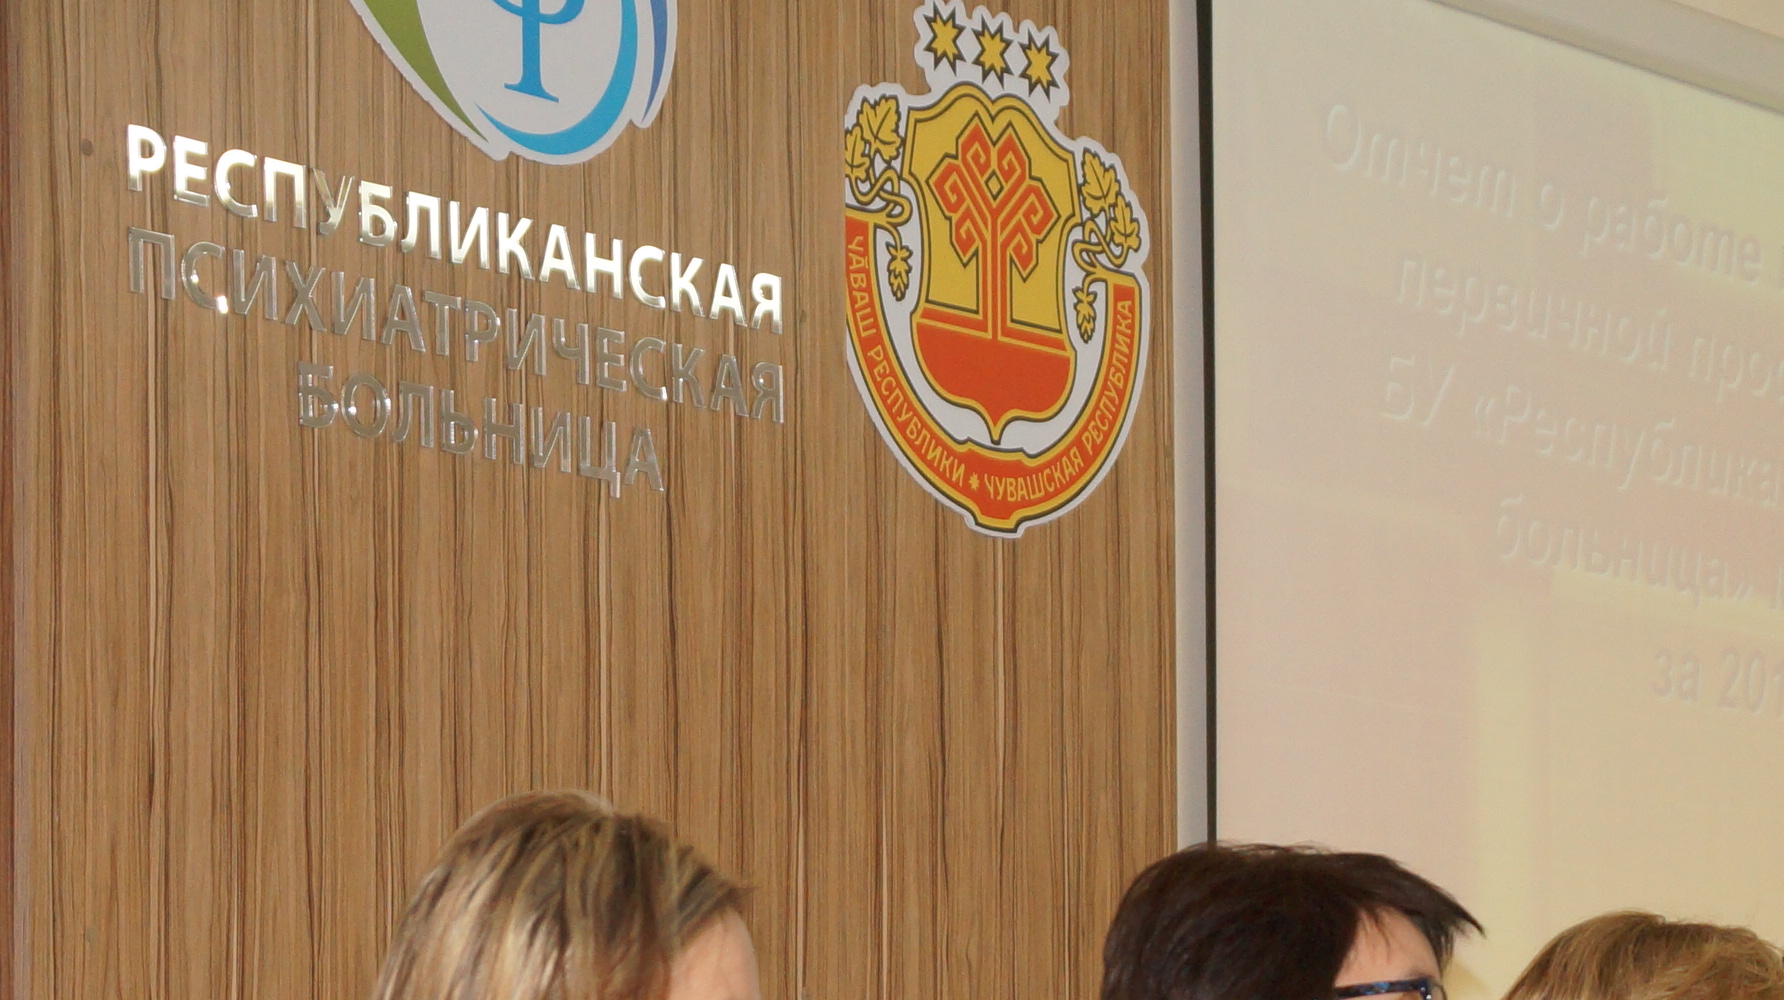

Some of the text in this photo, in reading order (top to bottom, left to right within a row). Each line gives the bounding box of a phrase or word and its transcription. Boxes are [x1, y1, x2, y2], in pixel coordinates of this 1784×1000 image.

[127, 123, 784, 335] РЕСПУБЛИКАНСКАЯ
[1322, 102, 1518, 219] Отчет
[1538, 181, 1565, 231] о
[1580, 190, 1763, 285] работе
[128, 227, 785, 424] ПСИХИАТРИЧЕСКАЯ
[1379, 353, 1457, 429] БУ
[1397, 253, 1674, 373] первичной
[299, 361, 664, 499] БОЛЬНИЦА
[867, 344, 966, 487] РЕСПУБЛИКИ
[984, 446, 1084, 501] ЧУВАШСКАЯ
[1081, 300, 1132, 455] РЕСПУБЛИКА
[1650, 647, 1702, 701] за
